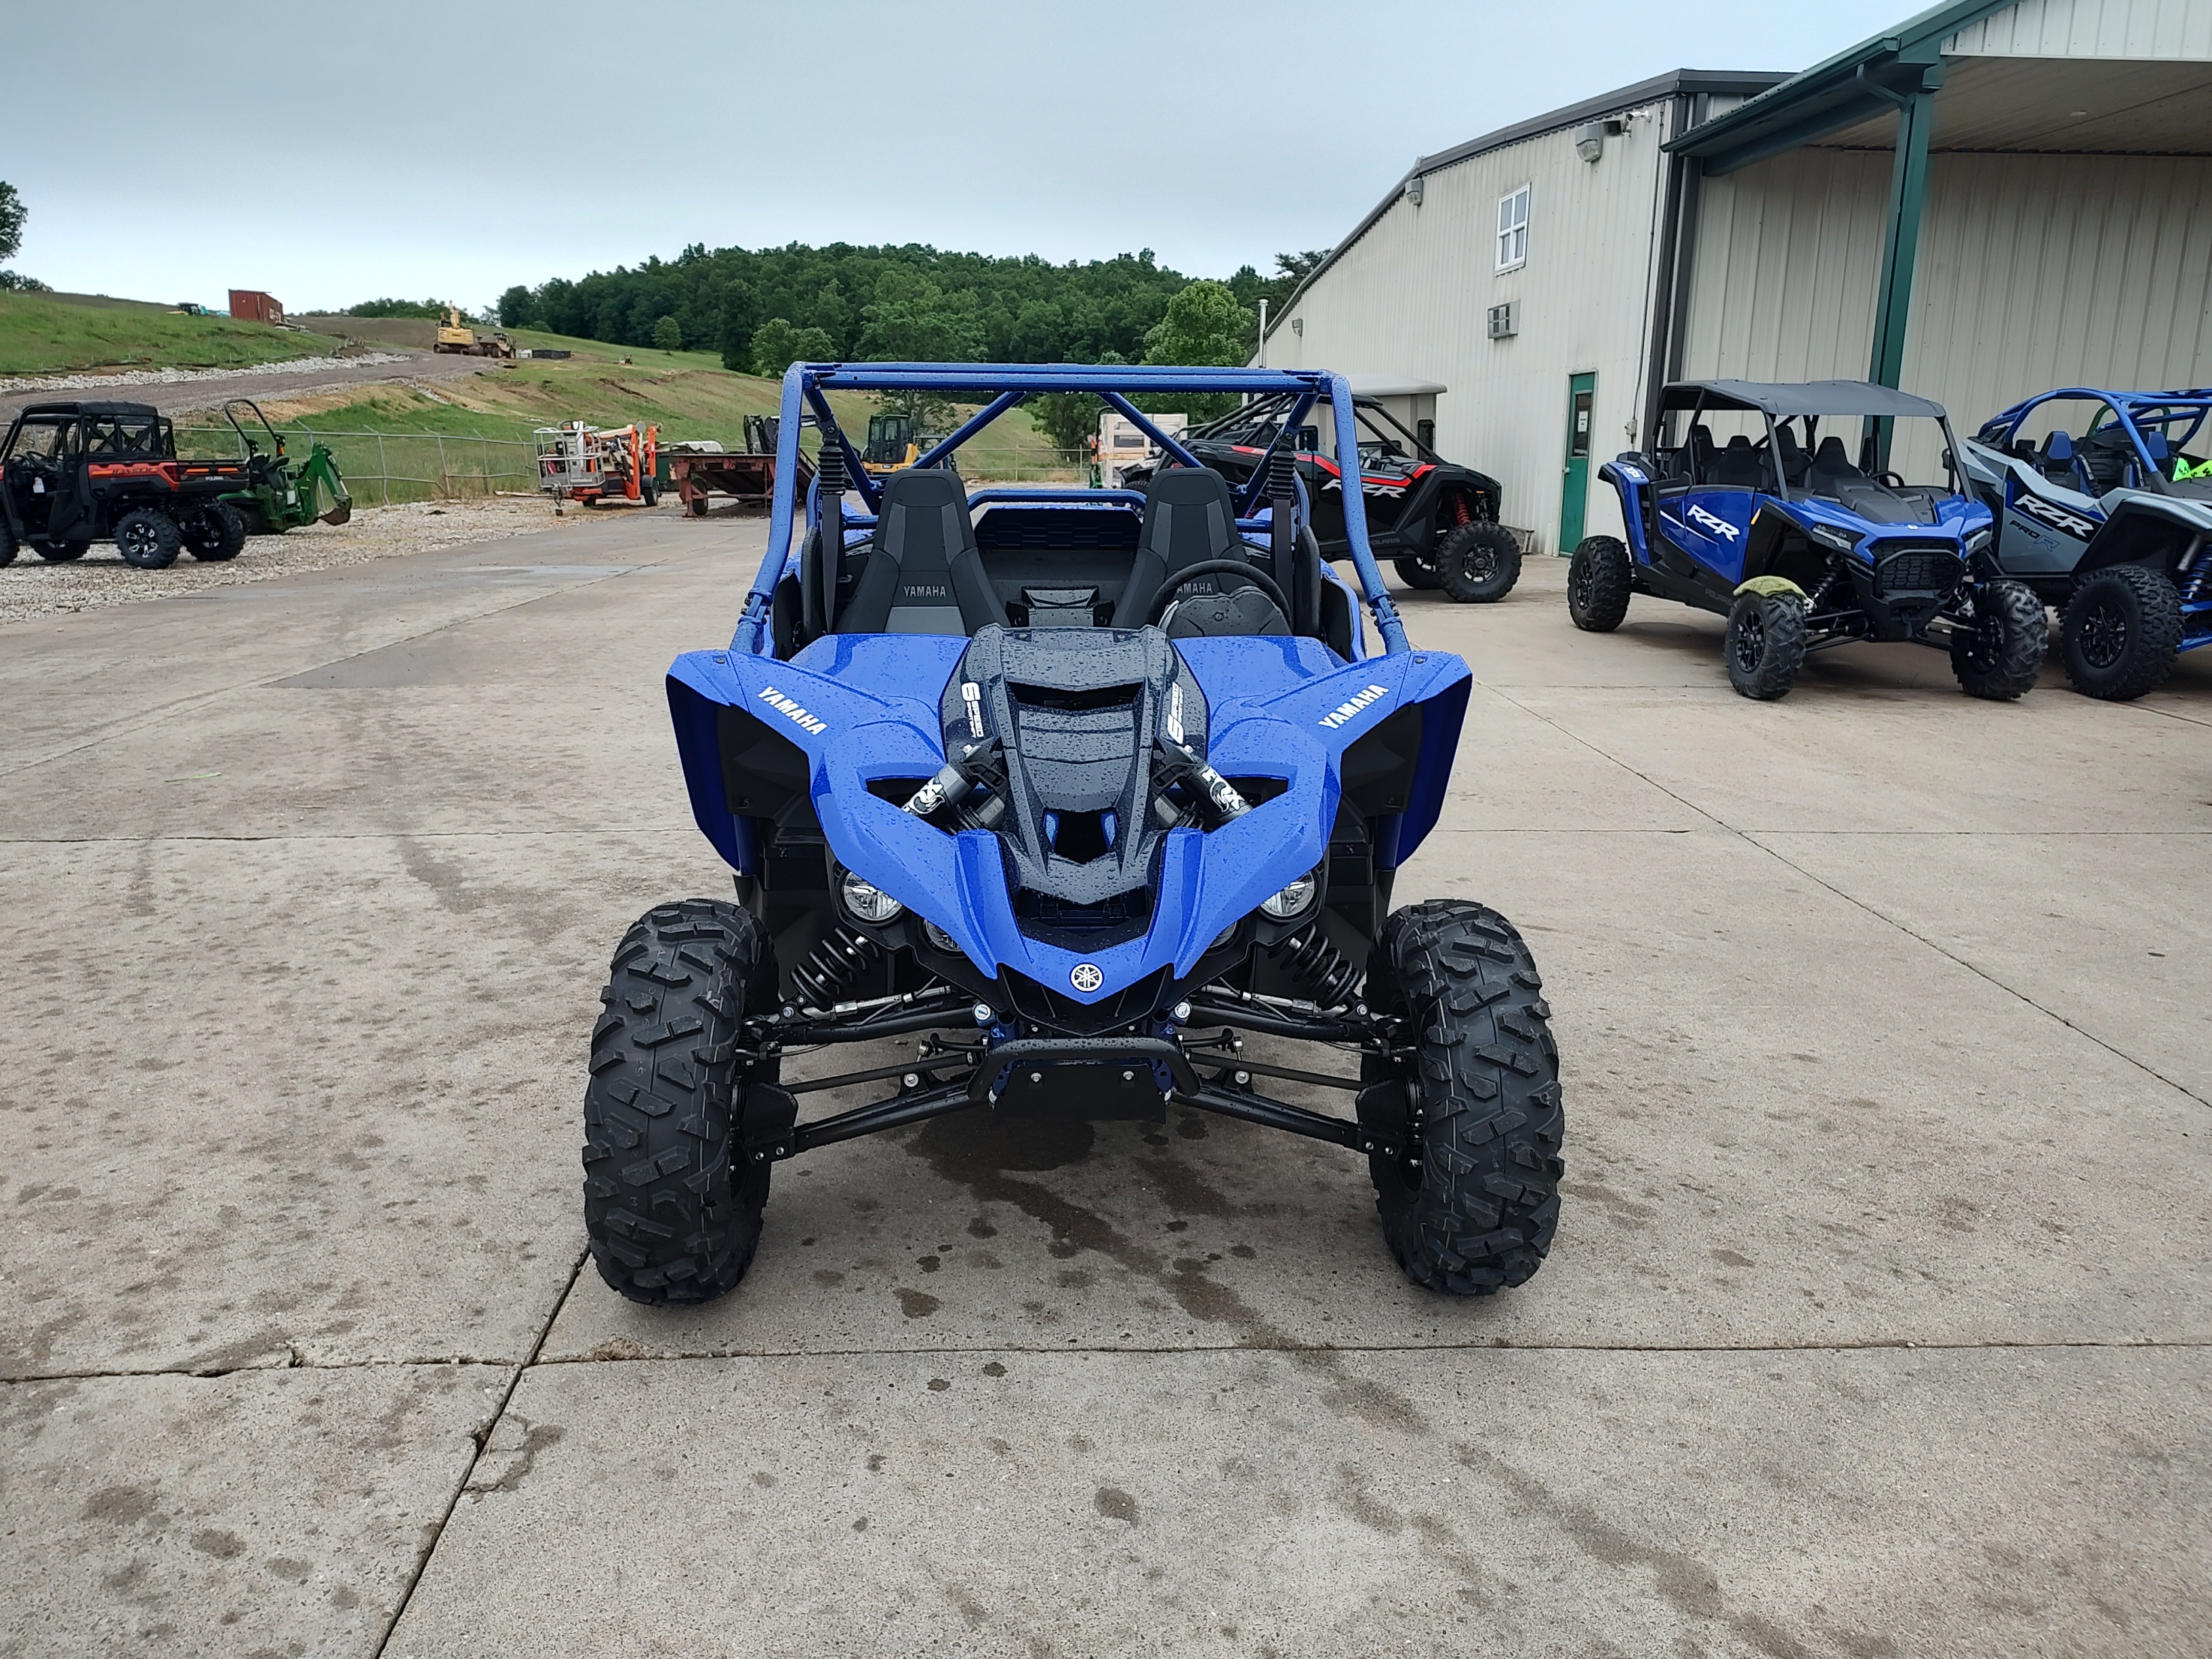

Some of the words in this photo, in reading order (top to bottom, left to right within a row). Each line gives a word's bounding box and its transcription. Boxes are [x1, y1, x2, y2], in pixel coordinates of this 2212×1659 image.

[1624, 466, 1641, 478] XP
[1687, 504, 1740, 542] RZR
[2009, 520, 2041, 539] PRO
[2014, 494, 2094, 537] RZR
[903, 586, 946, 597] YAMAHA
[1176, 583, 1212, 594] AMAHA
[758, 686, 827, 735] YAMAHA
[1317, 684, 1389, 729] YAMAHA
